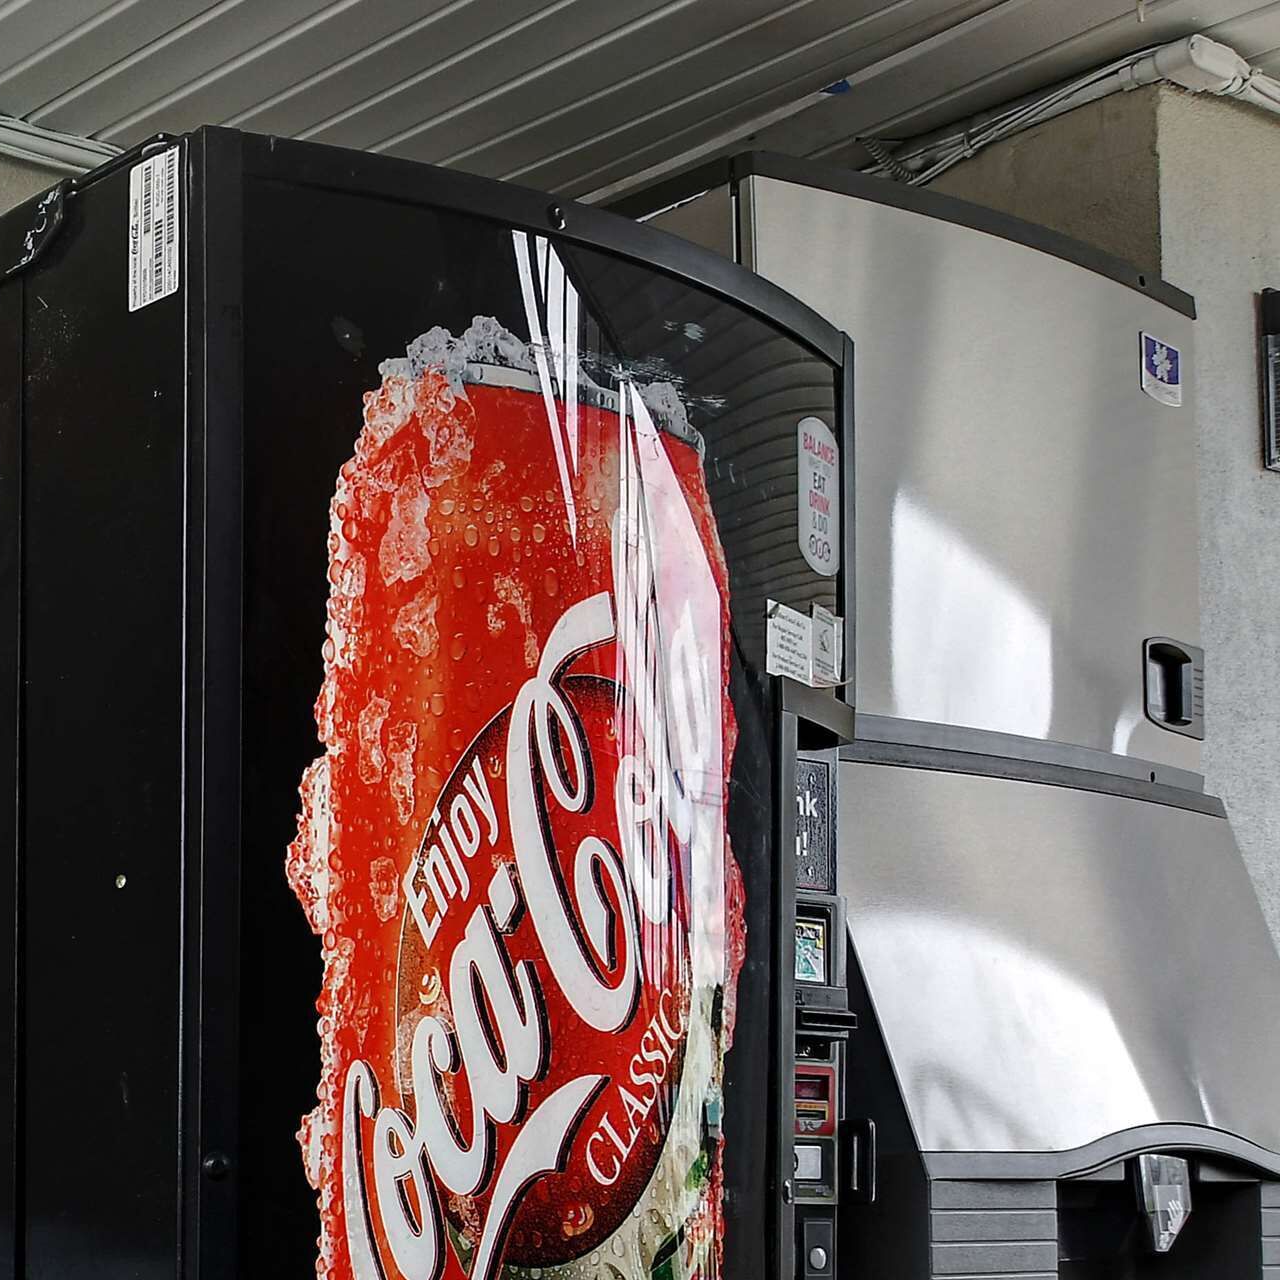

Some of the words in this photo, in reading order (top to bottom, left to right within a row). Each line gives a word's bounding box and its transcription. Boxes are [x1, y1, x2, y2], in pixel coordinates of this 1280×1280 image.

[813, 472, 826, 494] EAT
[402, 755, 499, 950] Enjoy
[586, 988, 685, 1185] CLASSIC
